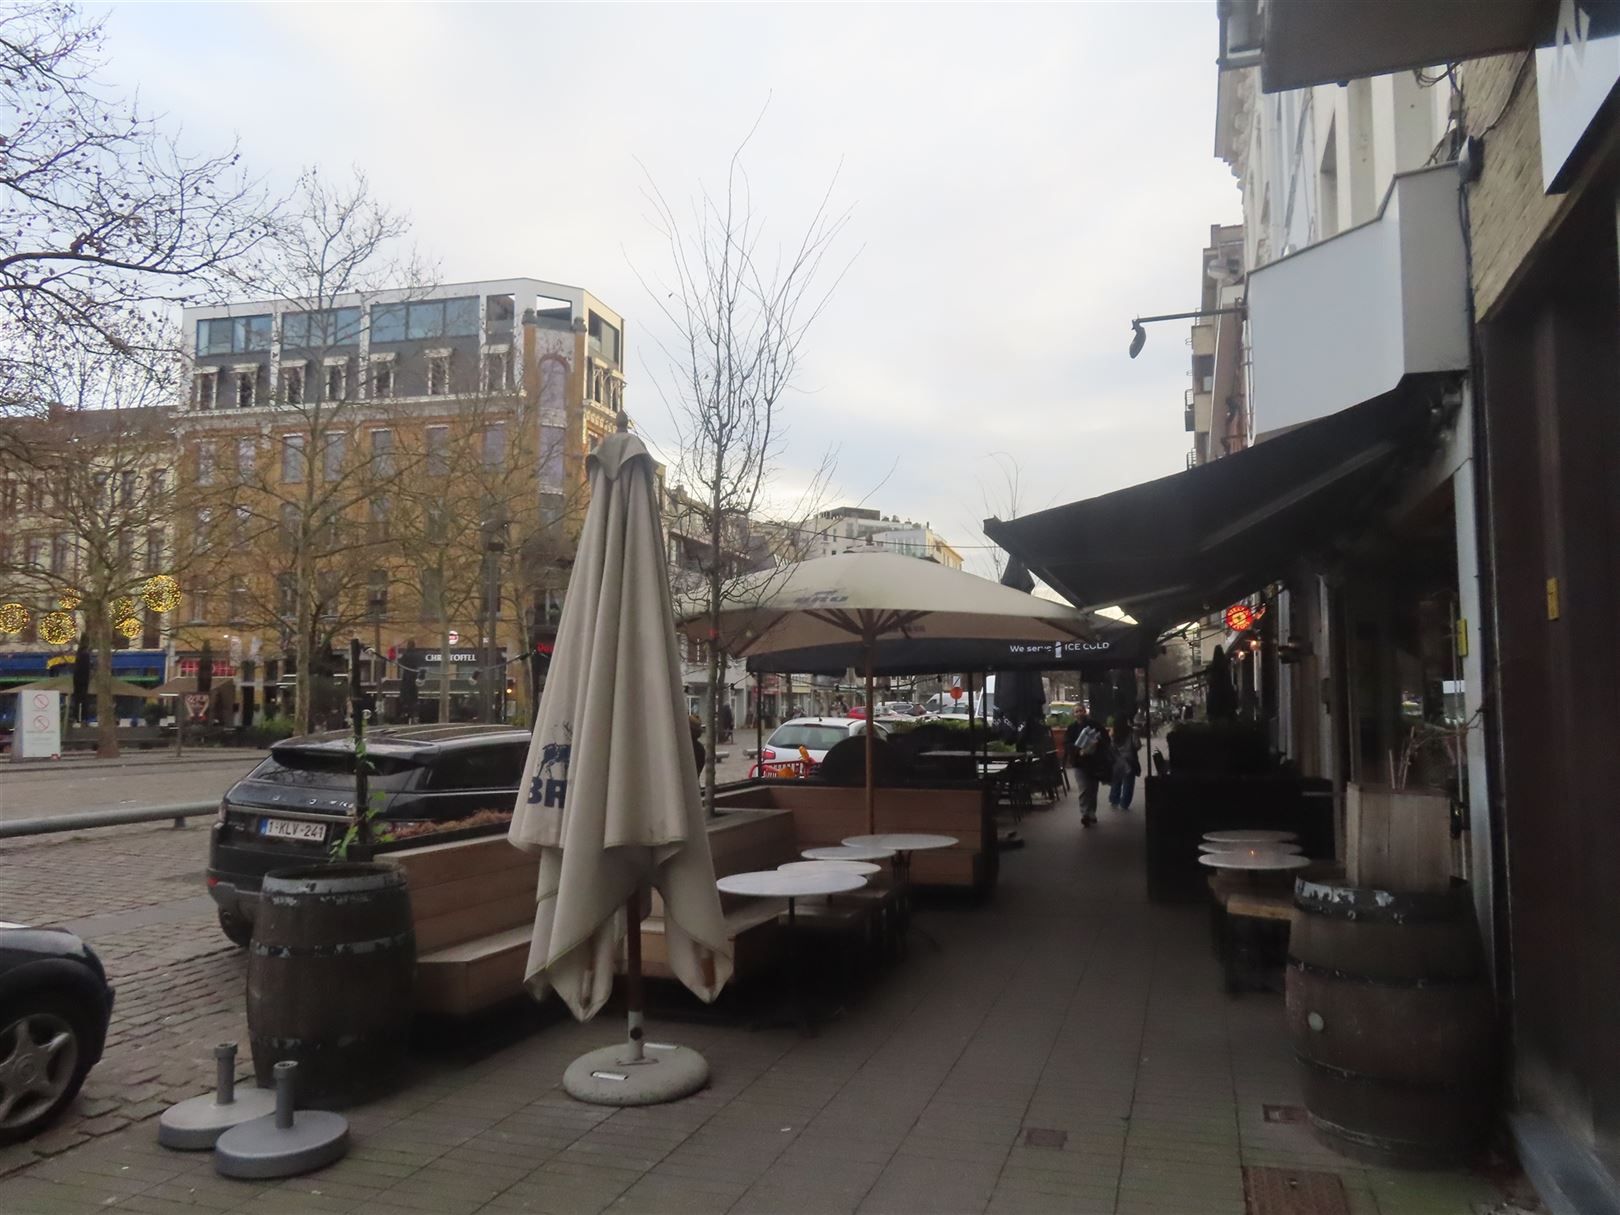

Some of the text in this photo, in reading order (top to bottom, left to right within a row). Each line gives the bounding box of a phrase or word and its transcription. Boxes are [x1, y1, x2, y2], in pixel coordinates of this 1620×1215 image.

[1009, 645, 1024, 653] We
[1064, 643, 1081, 651] ICE
[268, 821, 325, 838] 1-KLV-241
